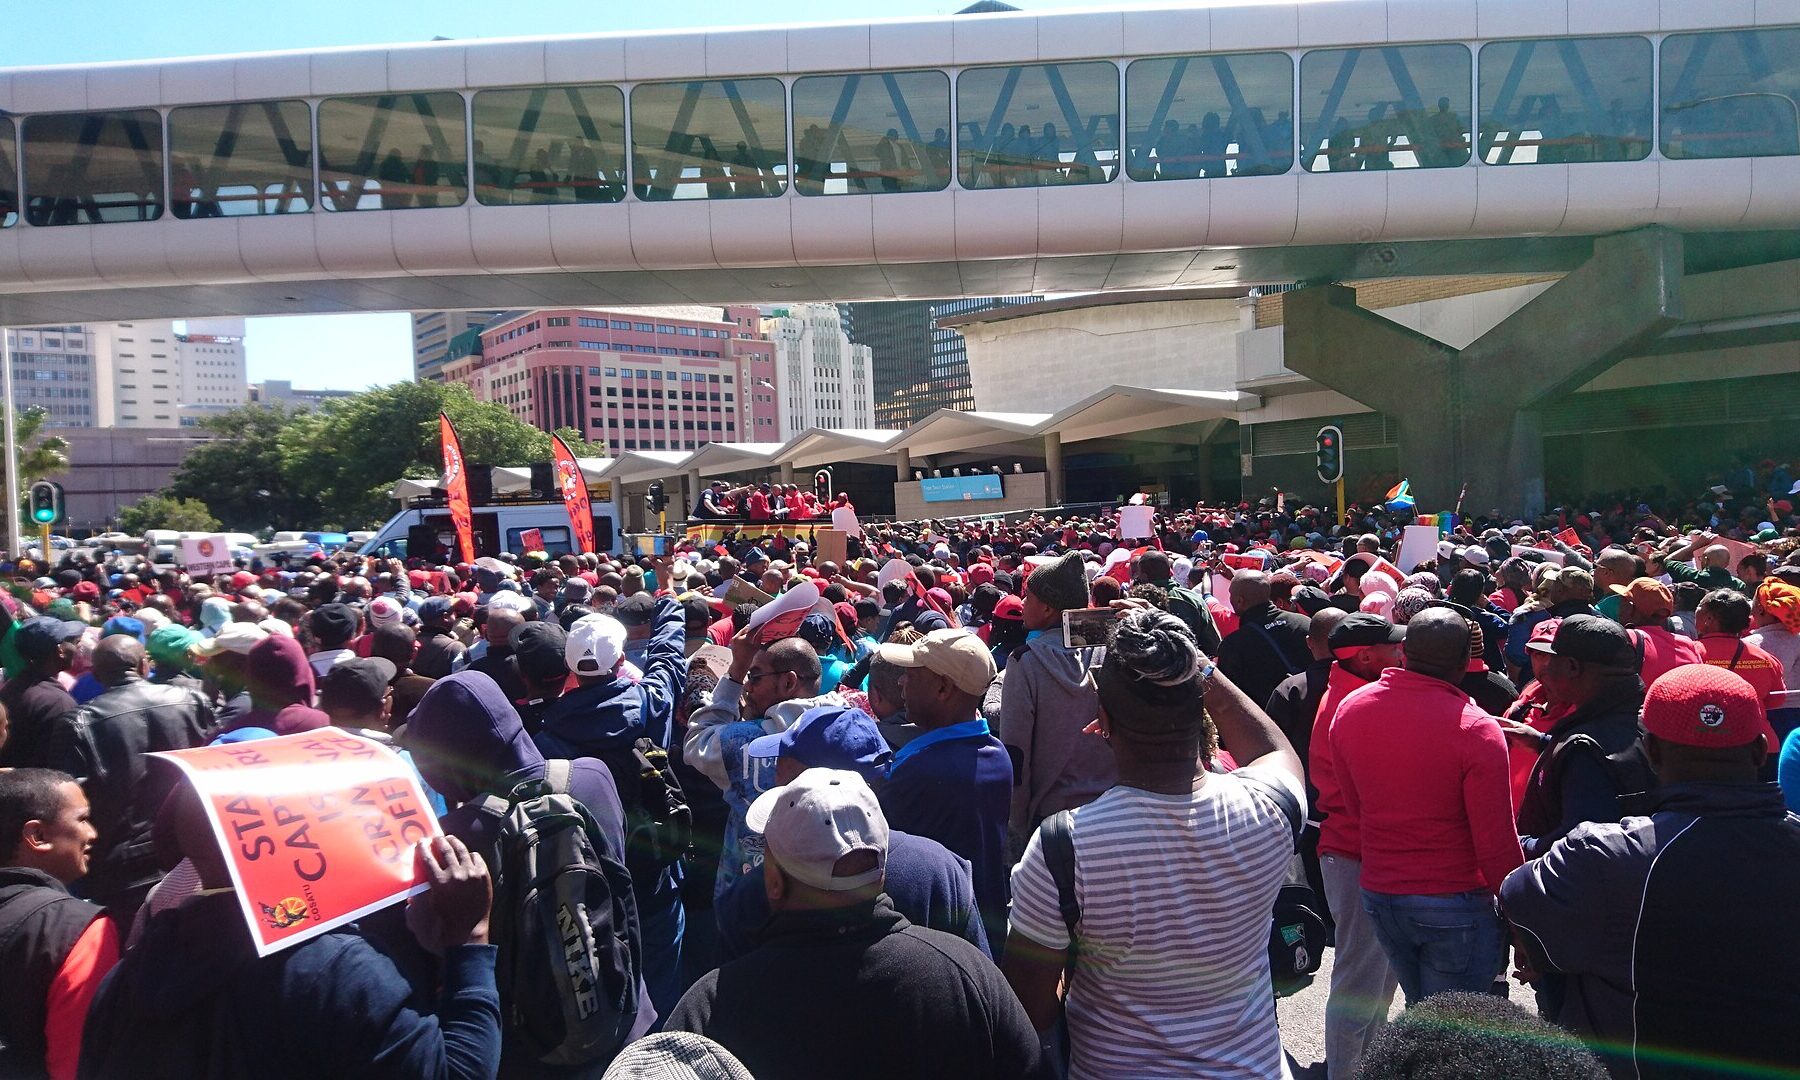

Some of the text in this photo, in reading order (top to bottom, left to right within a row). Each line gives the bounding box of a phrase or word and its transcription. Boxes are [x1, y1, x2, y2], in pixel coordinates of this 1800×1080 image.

[187, 560, 232, 571] WESTERN CAPE
[302, 884, 321, 921] COSATU
[556, 904, 599, 1020] NIKE
